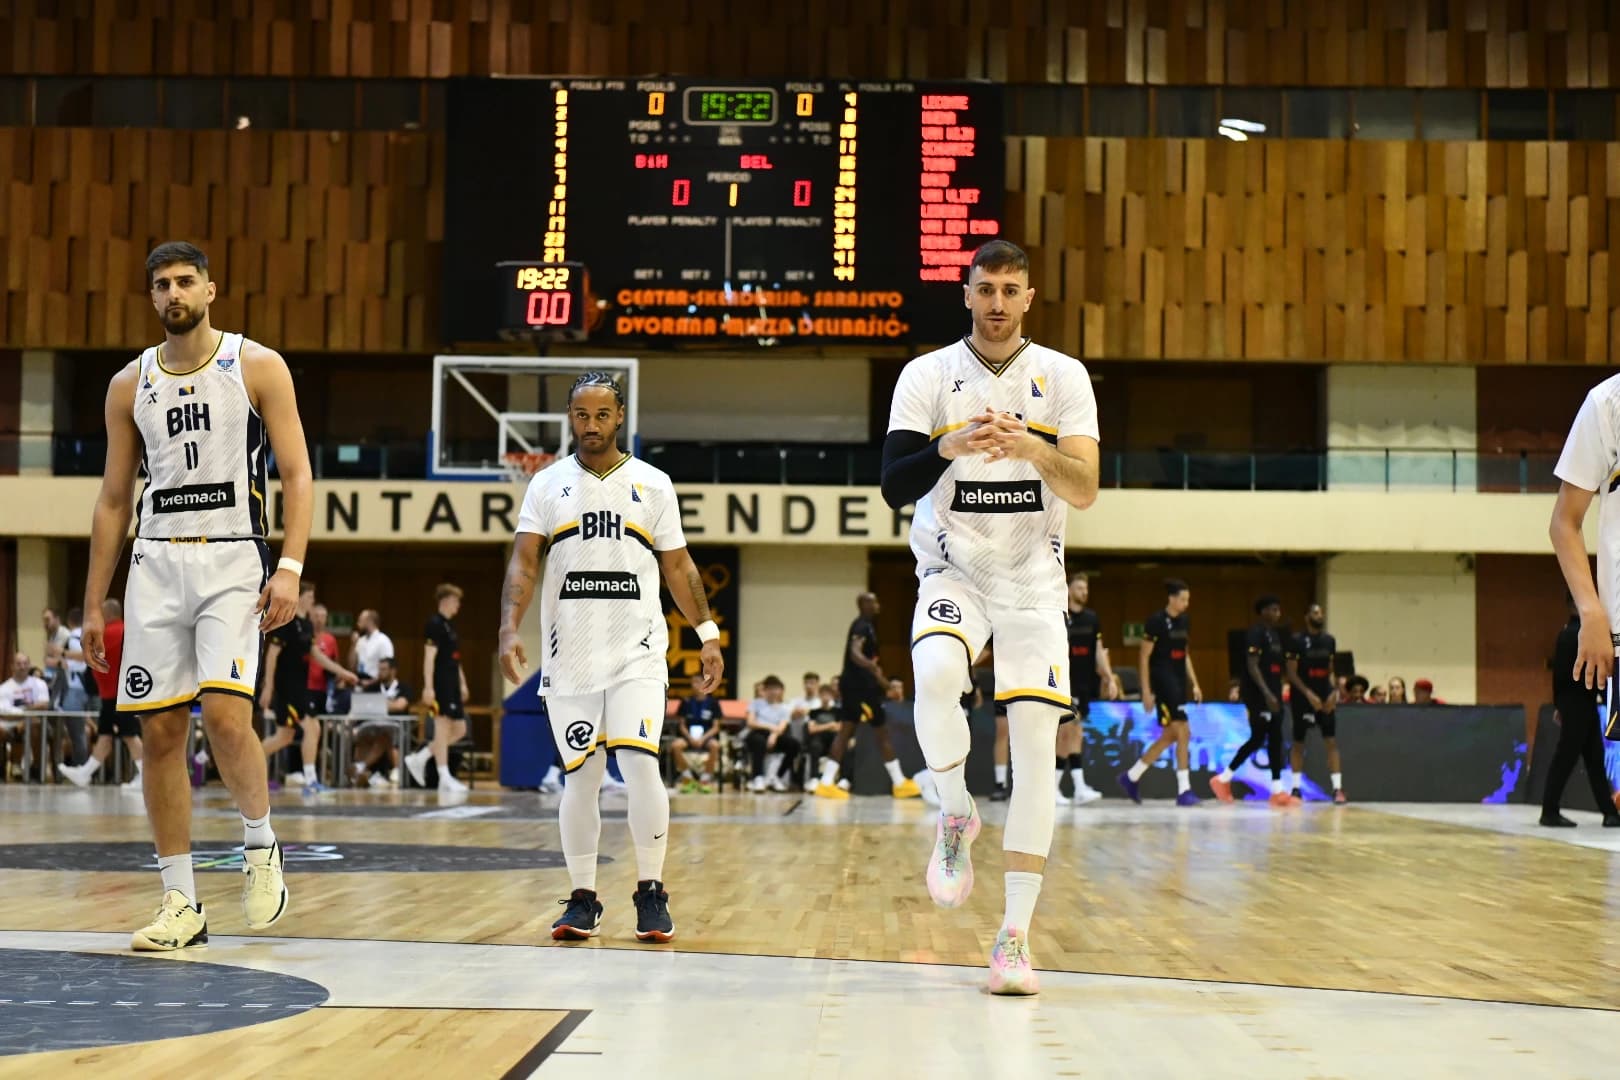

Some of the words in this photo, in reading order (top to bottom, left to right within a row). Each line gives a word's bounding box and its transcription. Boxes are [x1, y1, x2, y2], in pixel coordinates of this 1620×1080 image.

[555, 105, 568, 120] 2
[648, 92, 664, 115] 0
[702, 93, 770, 119] 19:22
[797, 93, 813, 116] 0
[555, 137, 567, 152] 4
[840, 139, 857, 154] 11
[554, 168, 566, 183] 7
[707, 172, 751, 183] PERIOD
[672, 180, 690, 206] 0
[729, 183, 738, 207] 1
[793, 180, 811, 206] 0
[549, 200, 566, 215] 11
[516, 267, 570, 290] 19:22
[527, 292, 571, 325] 00
[166, 402, 211, 438] BIH
[184, 441, 199, 470] 11
[582, 510, 622, 541] BIH
[565, 577, 637, 593] telemach
